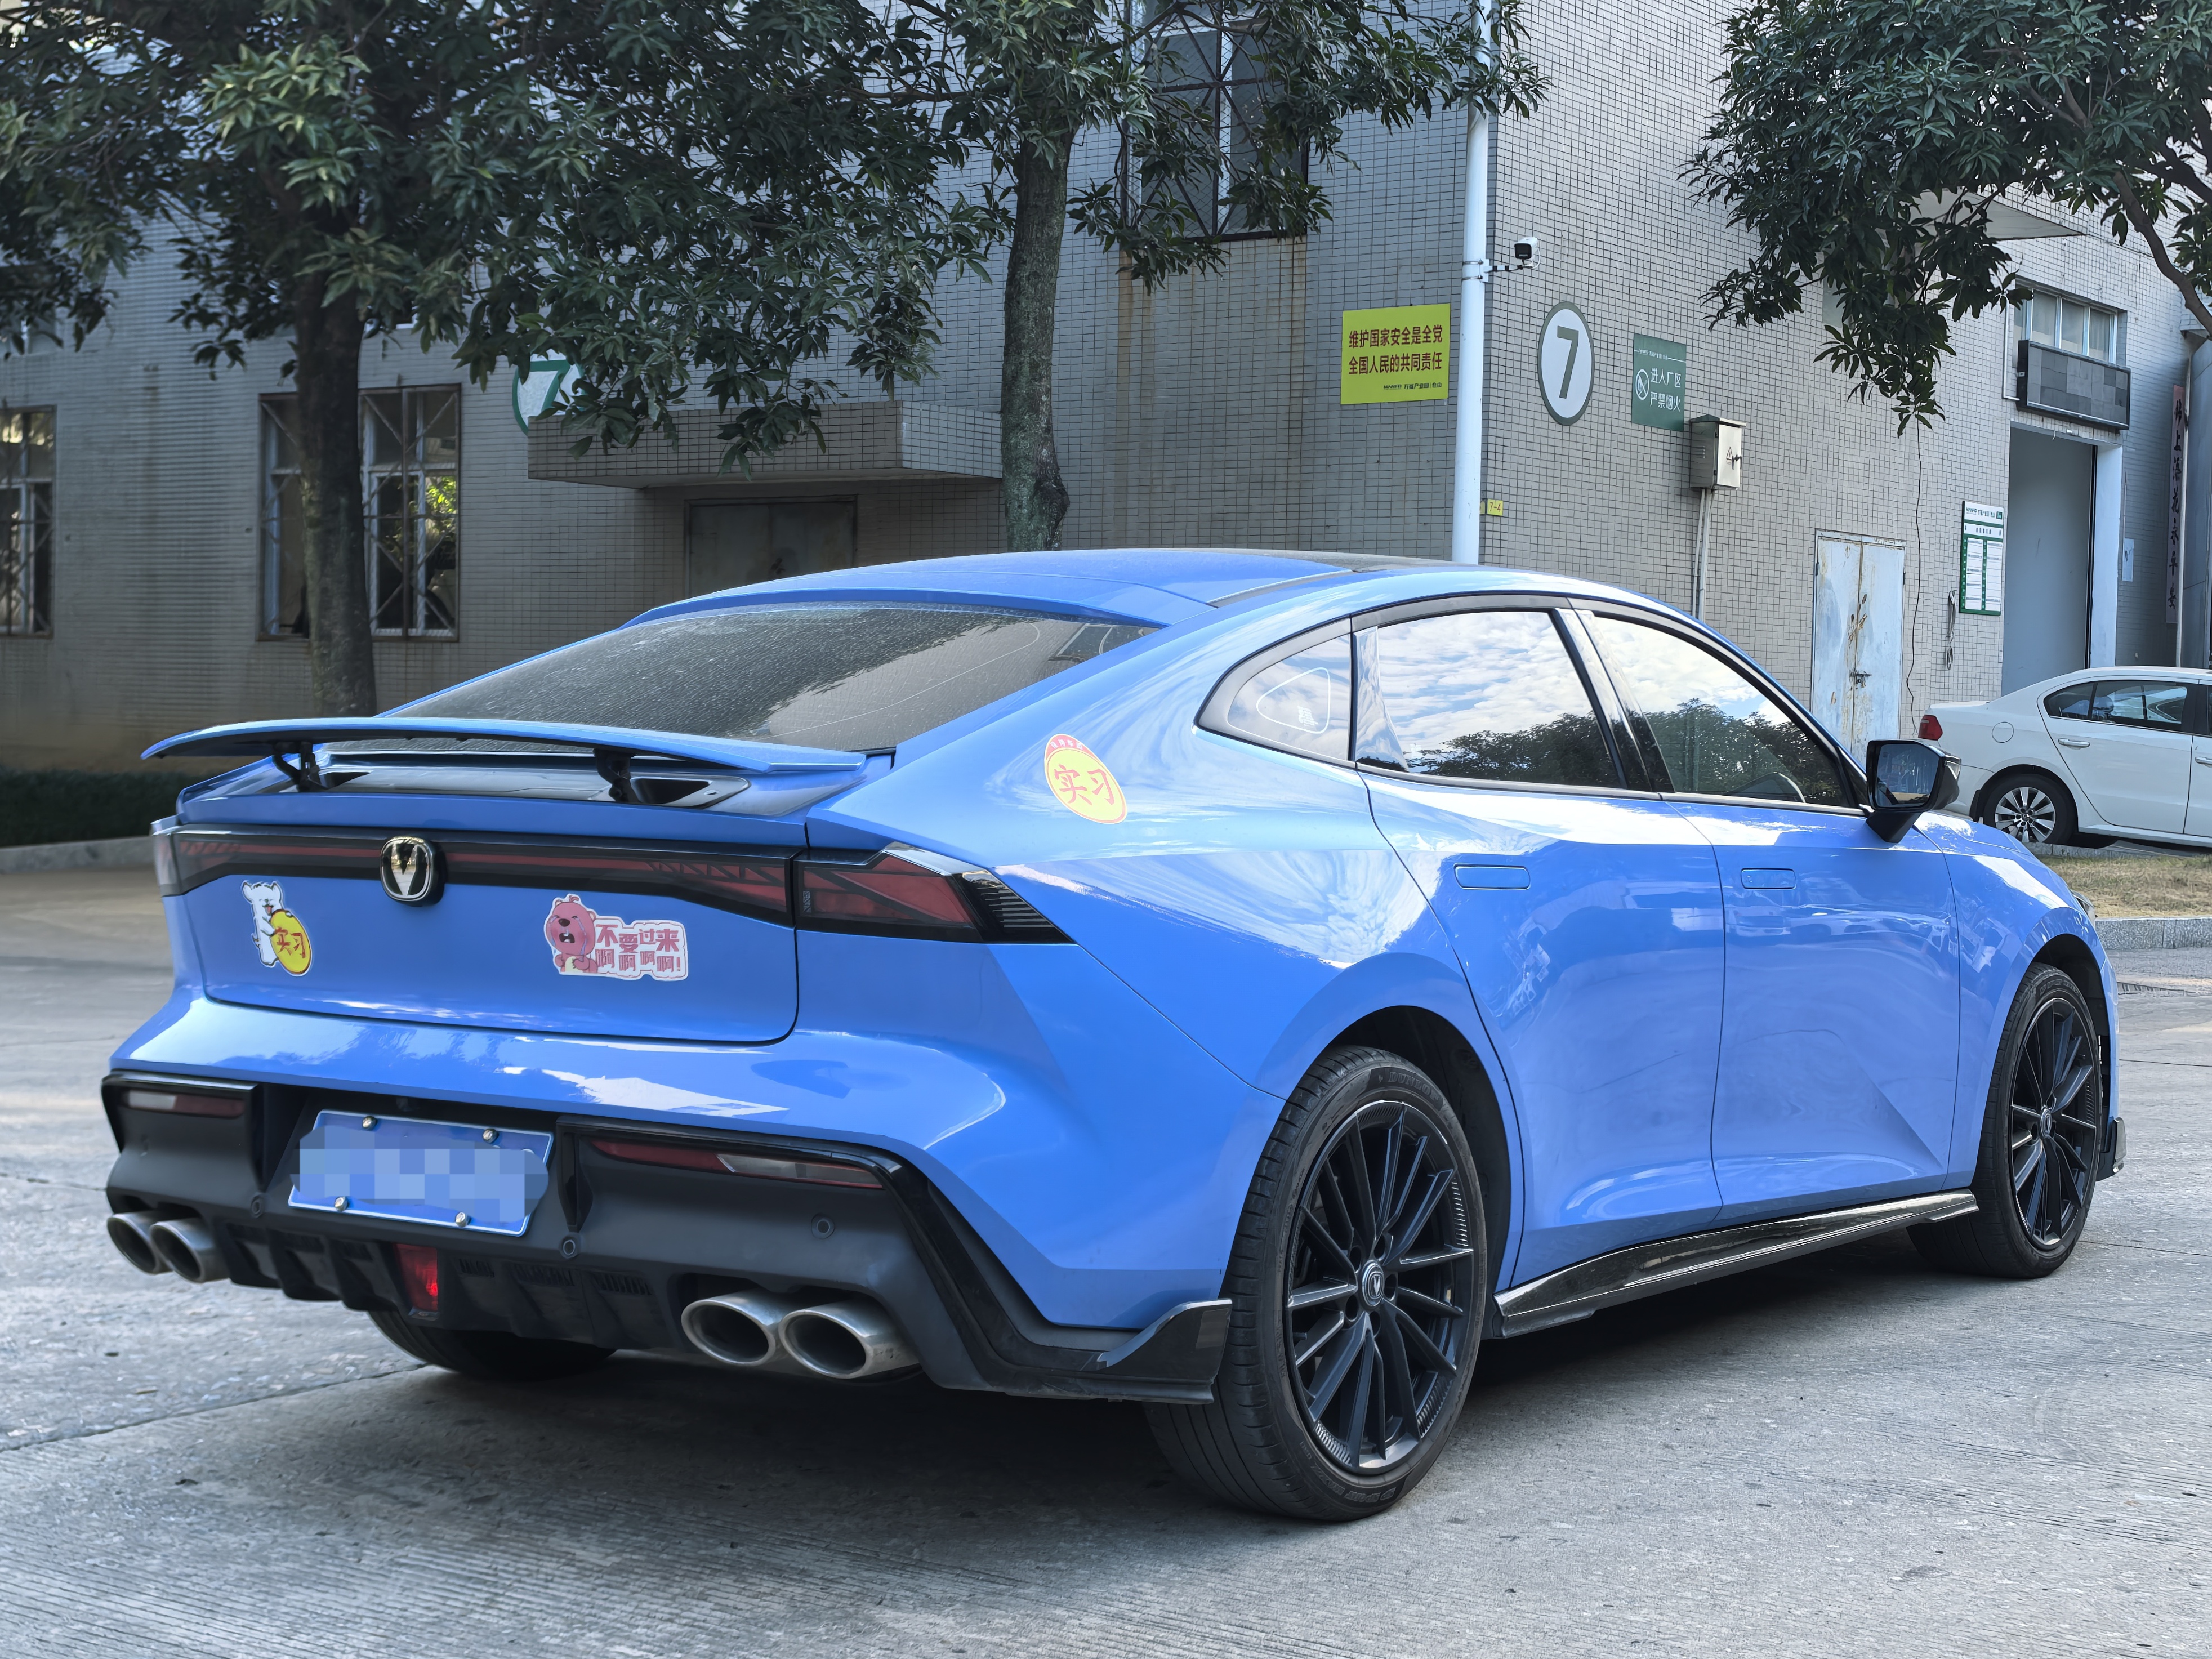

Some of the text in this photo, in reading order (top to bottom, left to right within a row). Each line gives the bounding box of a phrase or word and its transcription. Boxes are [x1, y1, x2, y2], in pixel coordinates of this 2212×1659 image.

[1349, 324, 1443, 348] 维护国家安全是全党
[1348, 351, 1442, 375] 全国人民的共同责任
[1557, 325, 1579, 399] 7
[529, 360, 571, 413] 7
[1650, 391, 1681, 412] 严禁烟火
[1489, 502, 1501, 513] 7-4
[1054, 764, 1115, 806] 实习
[274, 927, 306, 958] 实习
[595, 924, 680, 953] 不要过来
[1388, 1072, 1439, 1101] DUNLOP
